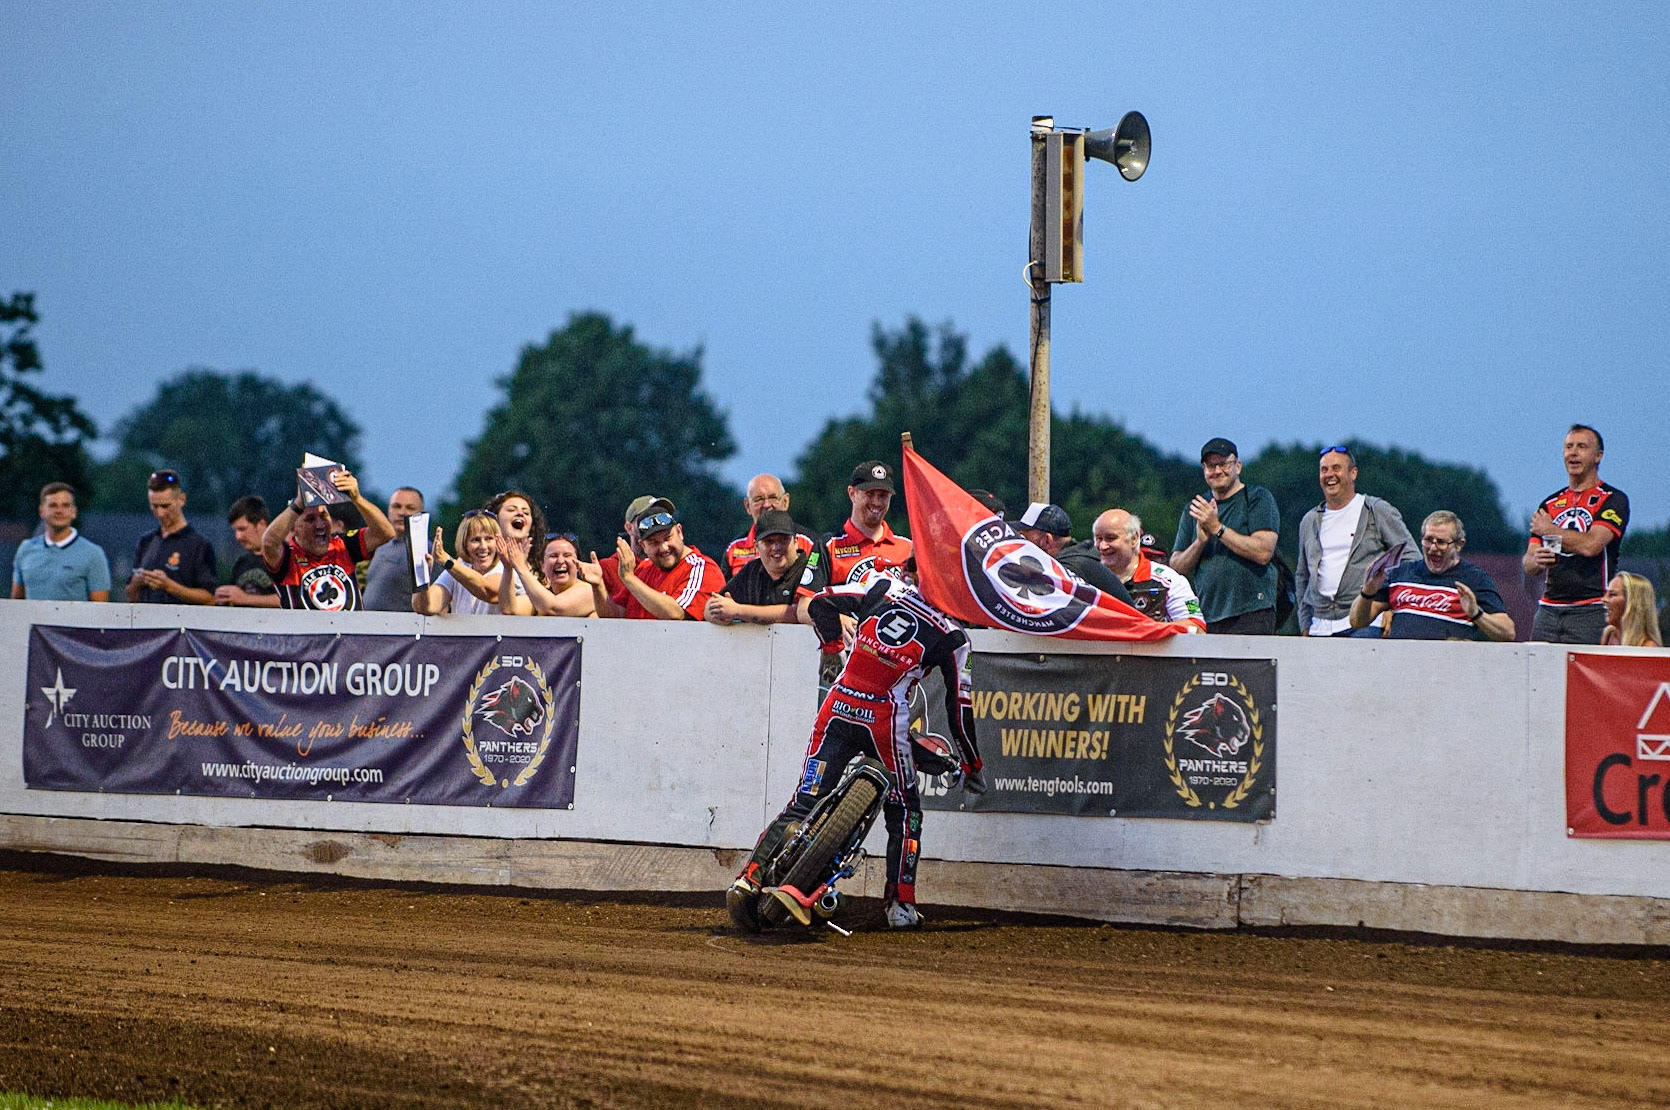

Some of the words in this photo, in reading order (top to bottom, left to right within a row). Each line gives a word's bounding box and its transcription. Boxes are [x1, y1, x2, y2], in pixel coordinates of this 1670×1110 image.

[858, 633, 913, 665] MANCHESTER
[501, 656, 523, 668] 50
[161, 656, 217, 690] CITY
[219, 659, 338, 695] AUCTION
[346, 663, 440, 697] GROUP
[1201, 672, 1228, 686] 50
[971, 690, 1080, 722] WORKING
[1087, 693, 1147, 724] WITH
[64, 713, 91, 728] CITY
[92, 714, 152, 730] AUCTION
[82, 733, 125, 748] GROUP
[168, 710, 229, 740] Because
[233, 721, 253, 736] we
[258, 713, 304, 738] value
[296, 721, 344, 757] your
[1001, 728, 1110, 760] WINNERS!
[479, 740, 538, 753] PANTHERS
[202, 759, 383, 786] www.cityauctiongroup.com
[1179, 758, 1248, 773] PANTHERS
[995, 774, 1113, 797] www.tengtools.com
